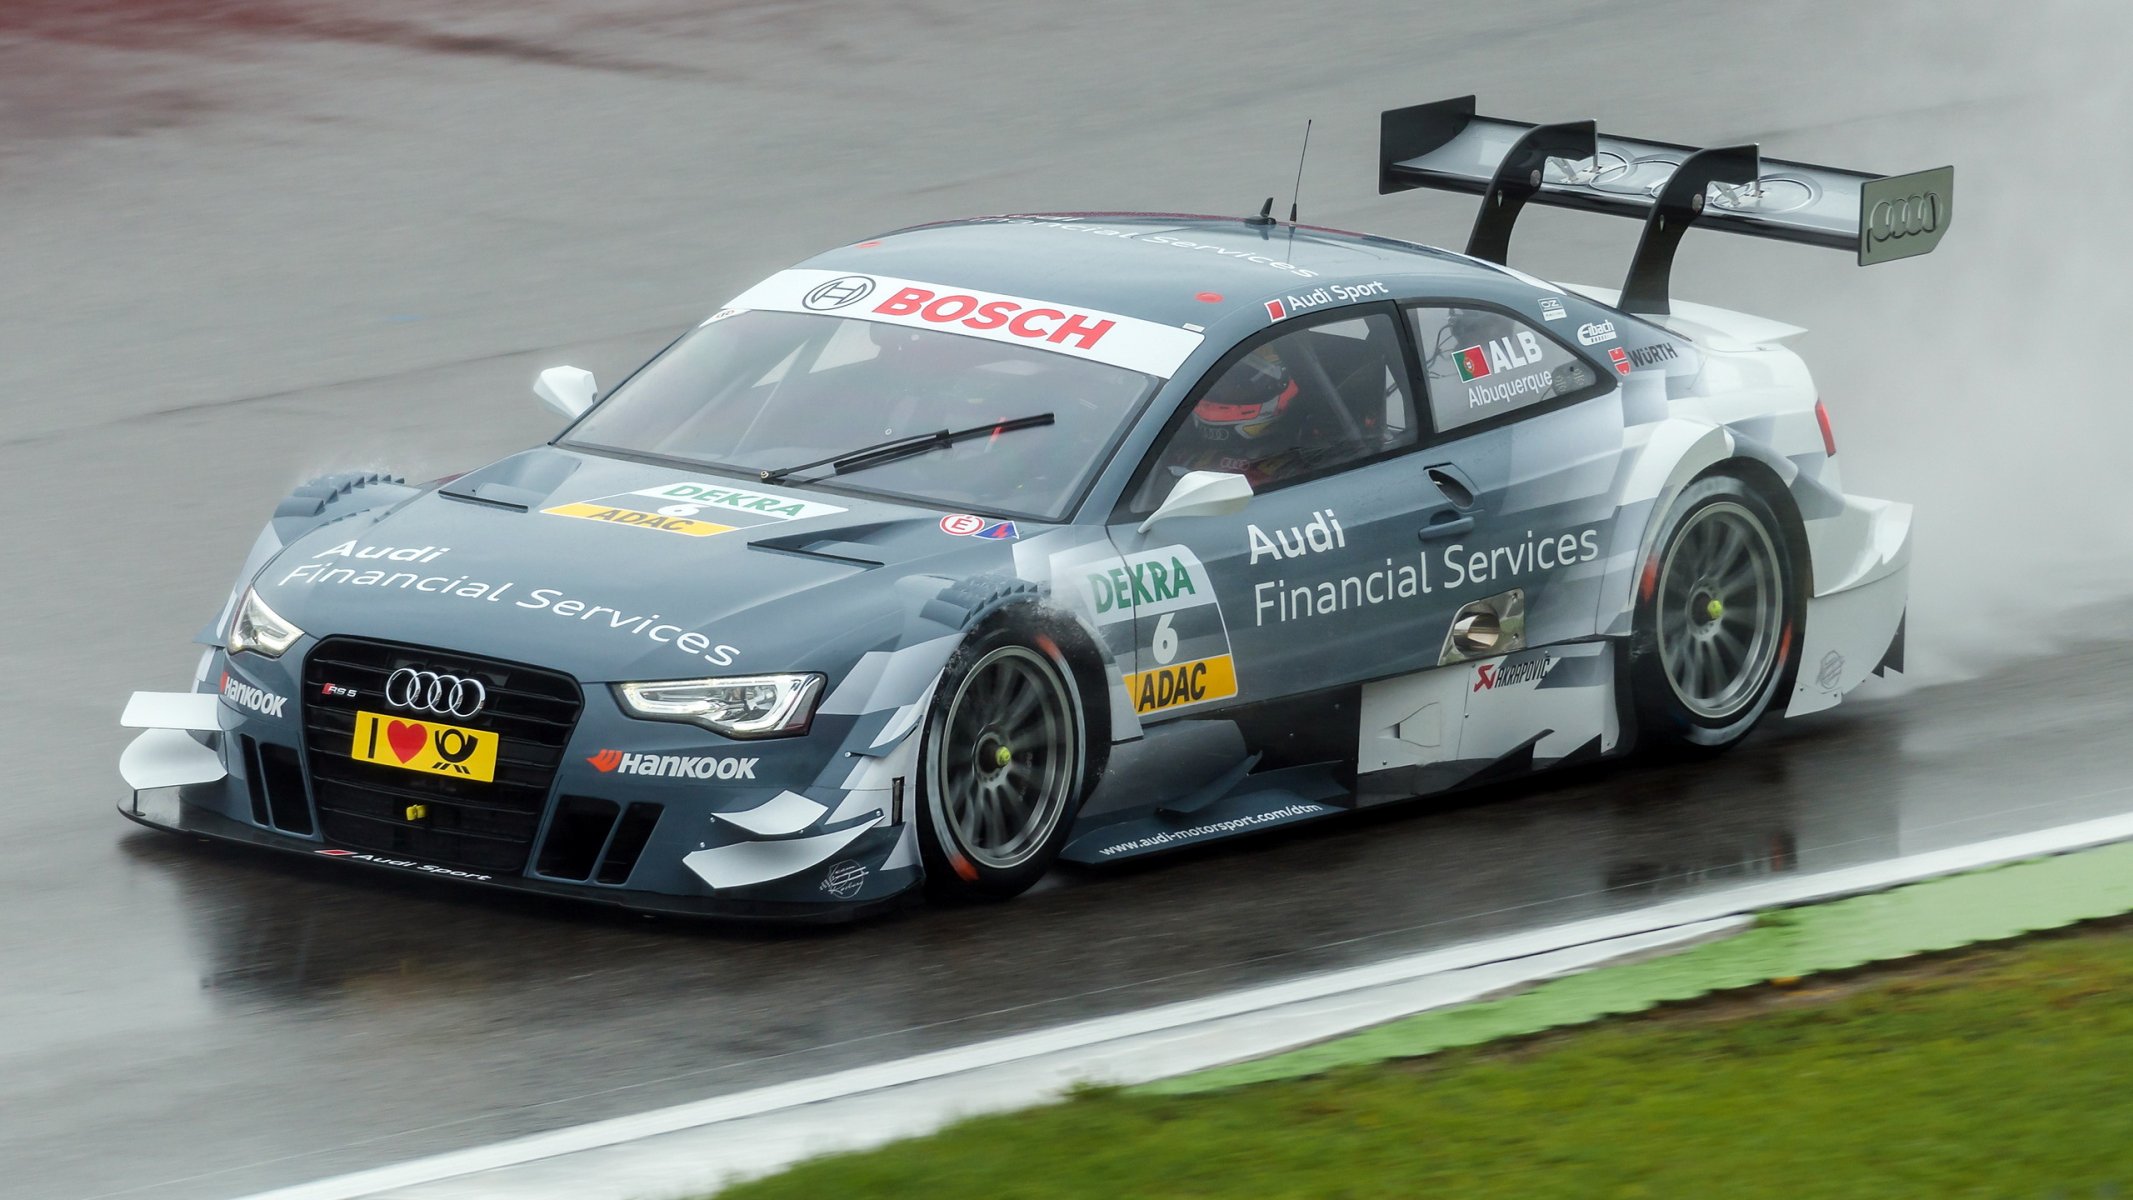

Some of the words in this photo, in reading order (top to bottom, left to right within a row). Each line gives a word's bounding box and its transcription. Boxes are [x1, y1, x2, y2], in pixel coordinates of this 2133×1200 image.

[1141, 235, 1319, 278] Services
[1287, 288, 1333, 311] Audi
[1330, 281, 1389, 302] Sport
[872, 287, 1117, 350] BOSCH
[1488, 331, 1543, 374] ALB
[1468, 370, 1553, 409] Albuquerque
[588, 509, 695, 531] ADAC
[657, 504, 712, 517] 6
[662, 485, 805, 517] DEKRA
[311, 539, 451, 564] Audi
[1247, 509, 1346, 565] Audi
[1087, 556, 1195, 614] DEKRA
[1254, 551, 1432, 627] Financial
[1443, 529, 1600, 589] Services
[277, 563, 514, 602] Financial
[516, 588, 741, 667] Services
[1152, 612, 1179, 665] 6
[1138, 662, 1207, 712] ADAC
[368, 717, 379, 759] I
[1099, 803, 1323, 857] www.audi-motorsport.com/dtm
[351, 854, 417, 867] Audi
[417, 864, 492, 881] Sport
